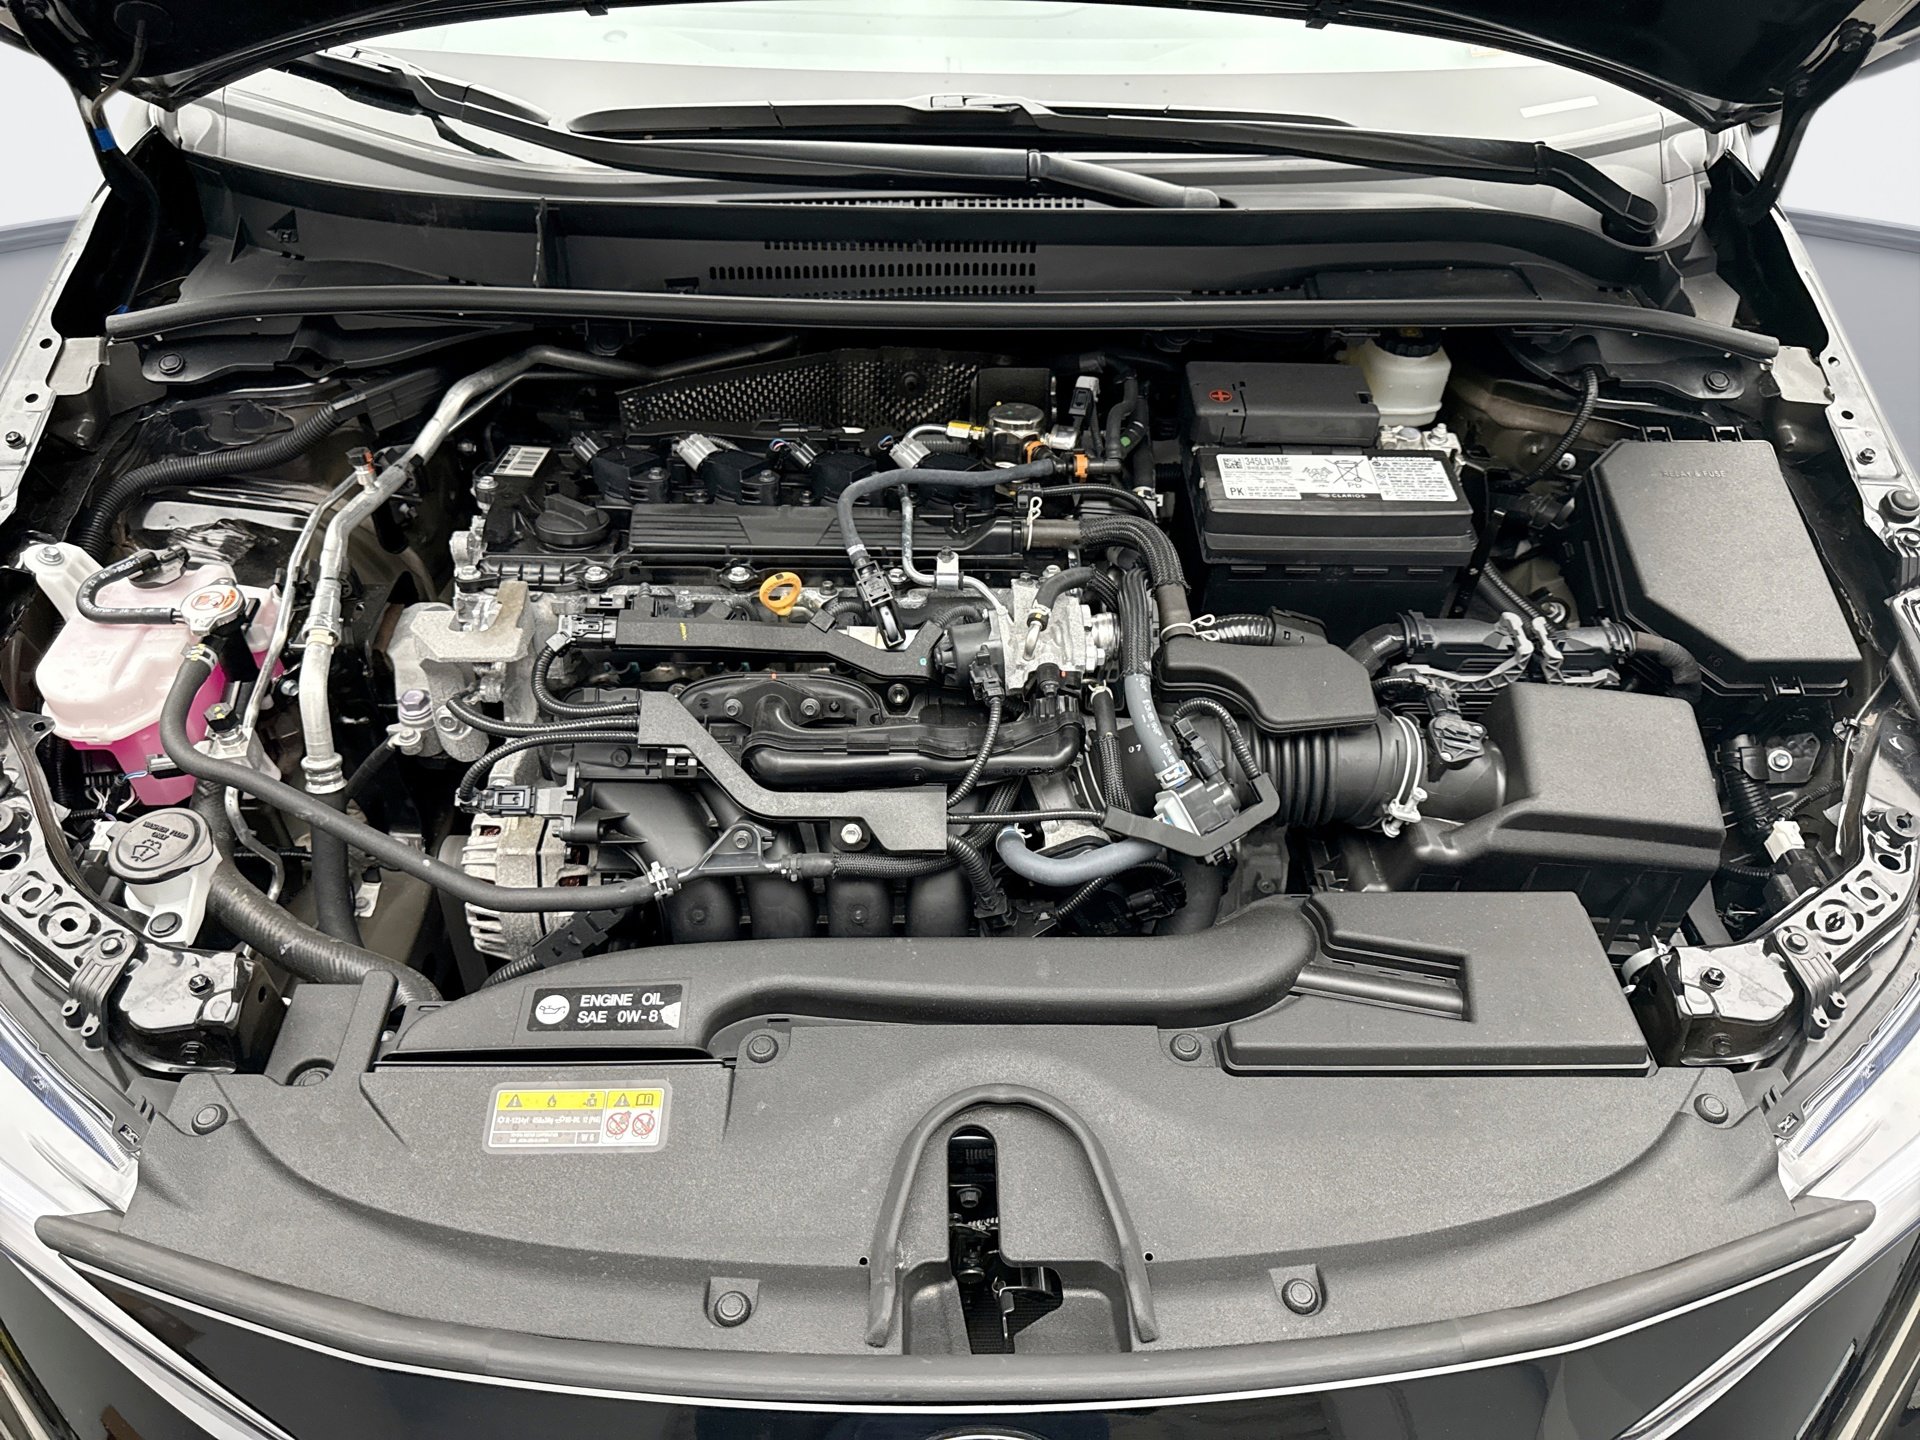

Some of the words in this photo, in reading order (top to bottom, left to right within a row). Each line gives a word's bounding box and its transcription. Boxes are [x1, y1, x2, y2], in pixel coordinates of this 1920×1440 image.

[1703, 470, 1727, 478] FUSE
[1229, 487, 1245, 496] PK
[151, 831, 170, 841] ONLY
[580, 993, 633, 1007] ENGINE
[641, 992, 665, 1006] OIL
[577, 1010, 608, 1024] SAE
[617, 1009, 659, 1023] 0W-8
